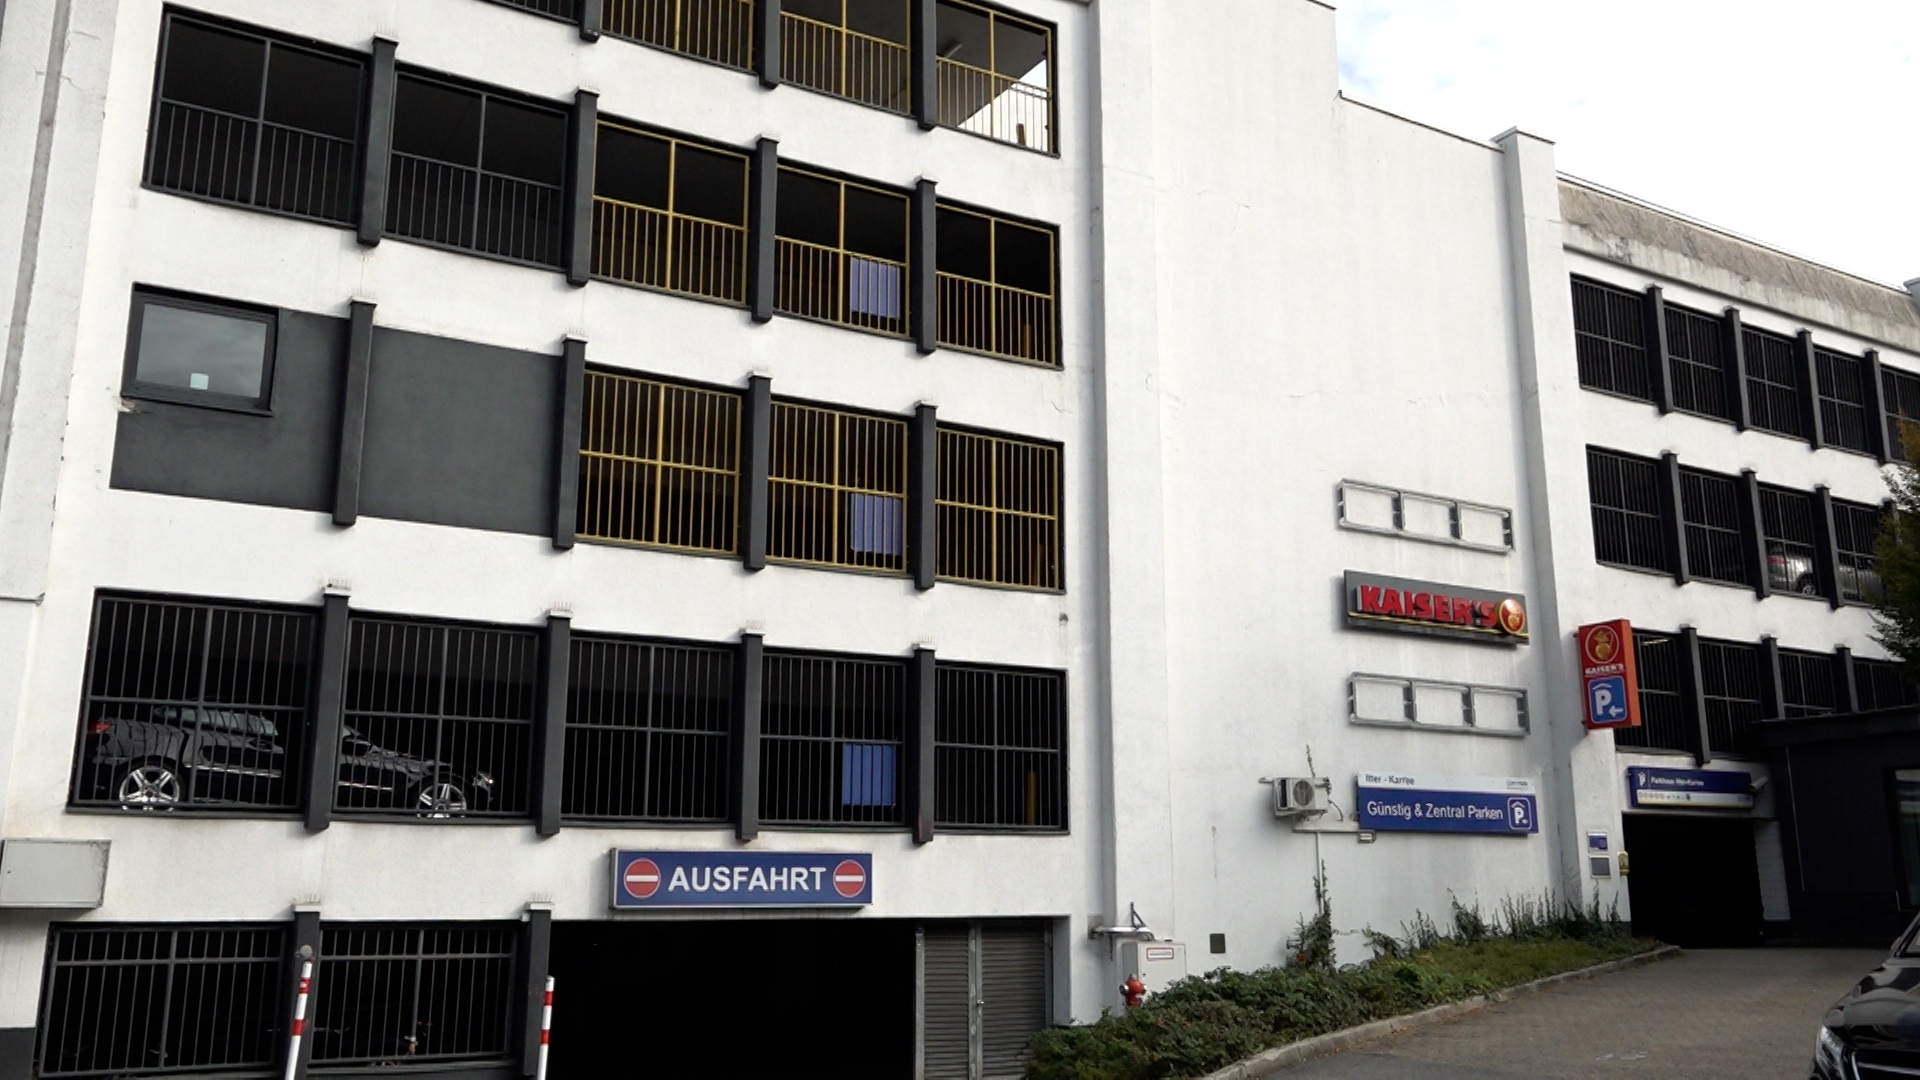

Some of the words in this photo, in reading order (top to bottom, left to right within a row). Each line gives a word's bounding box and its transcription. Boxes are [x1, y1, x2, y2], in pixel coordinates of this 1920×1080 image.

[1358, 585, 1498, 628] KAISER'S
[1367, 800, 1412, 820] Günstig
[1414, 803, 1423, 818] &
[1425, 803, 1465, 819] Zentral
[1467, 805, 1504, 820] Parken
[667, 866, 827, 892] AUSFAHRT
